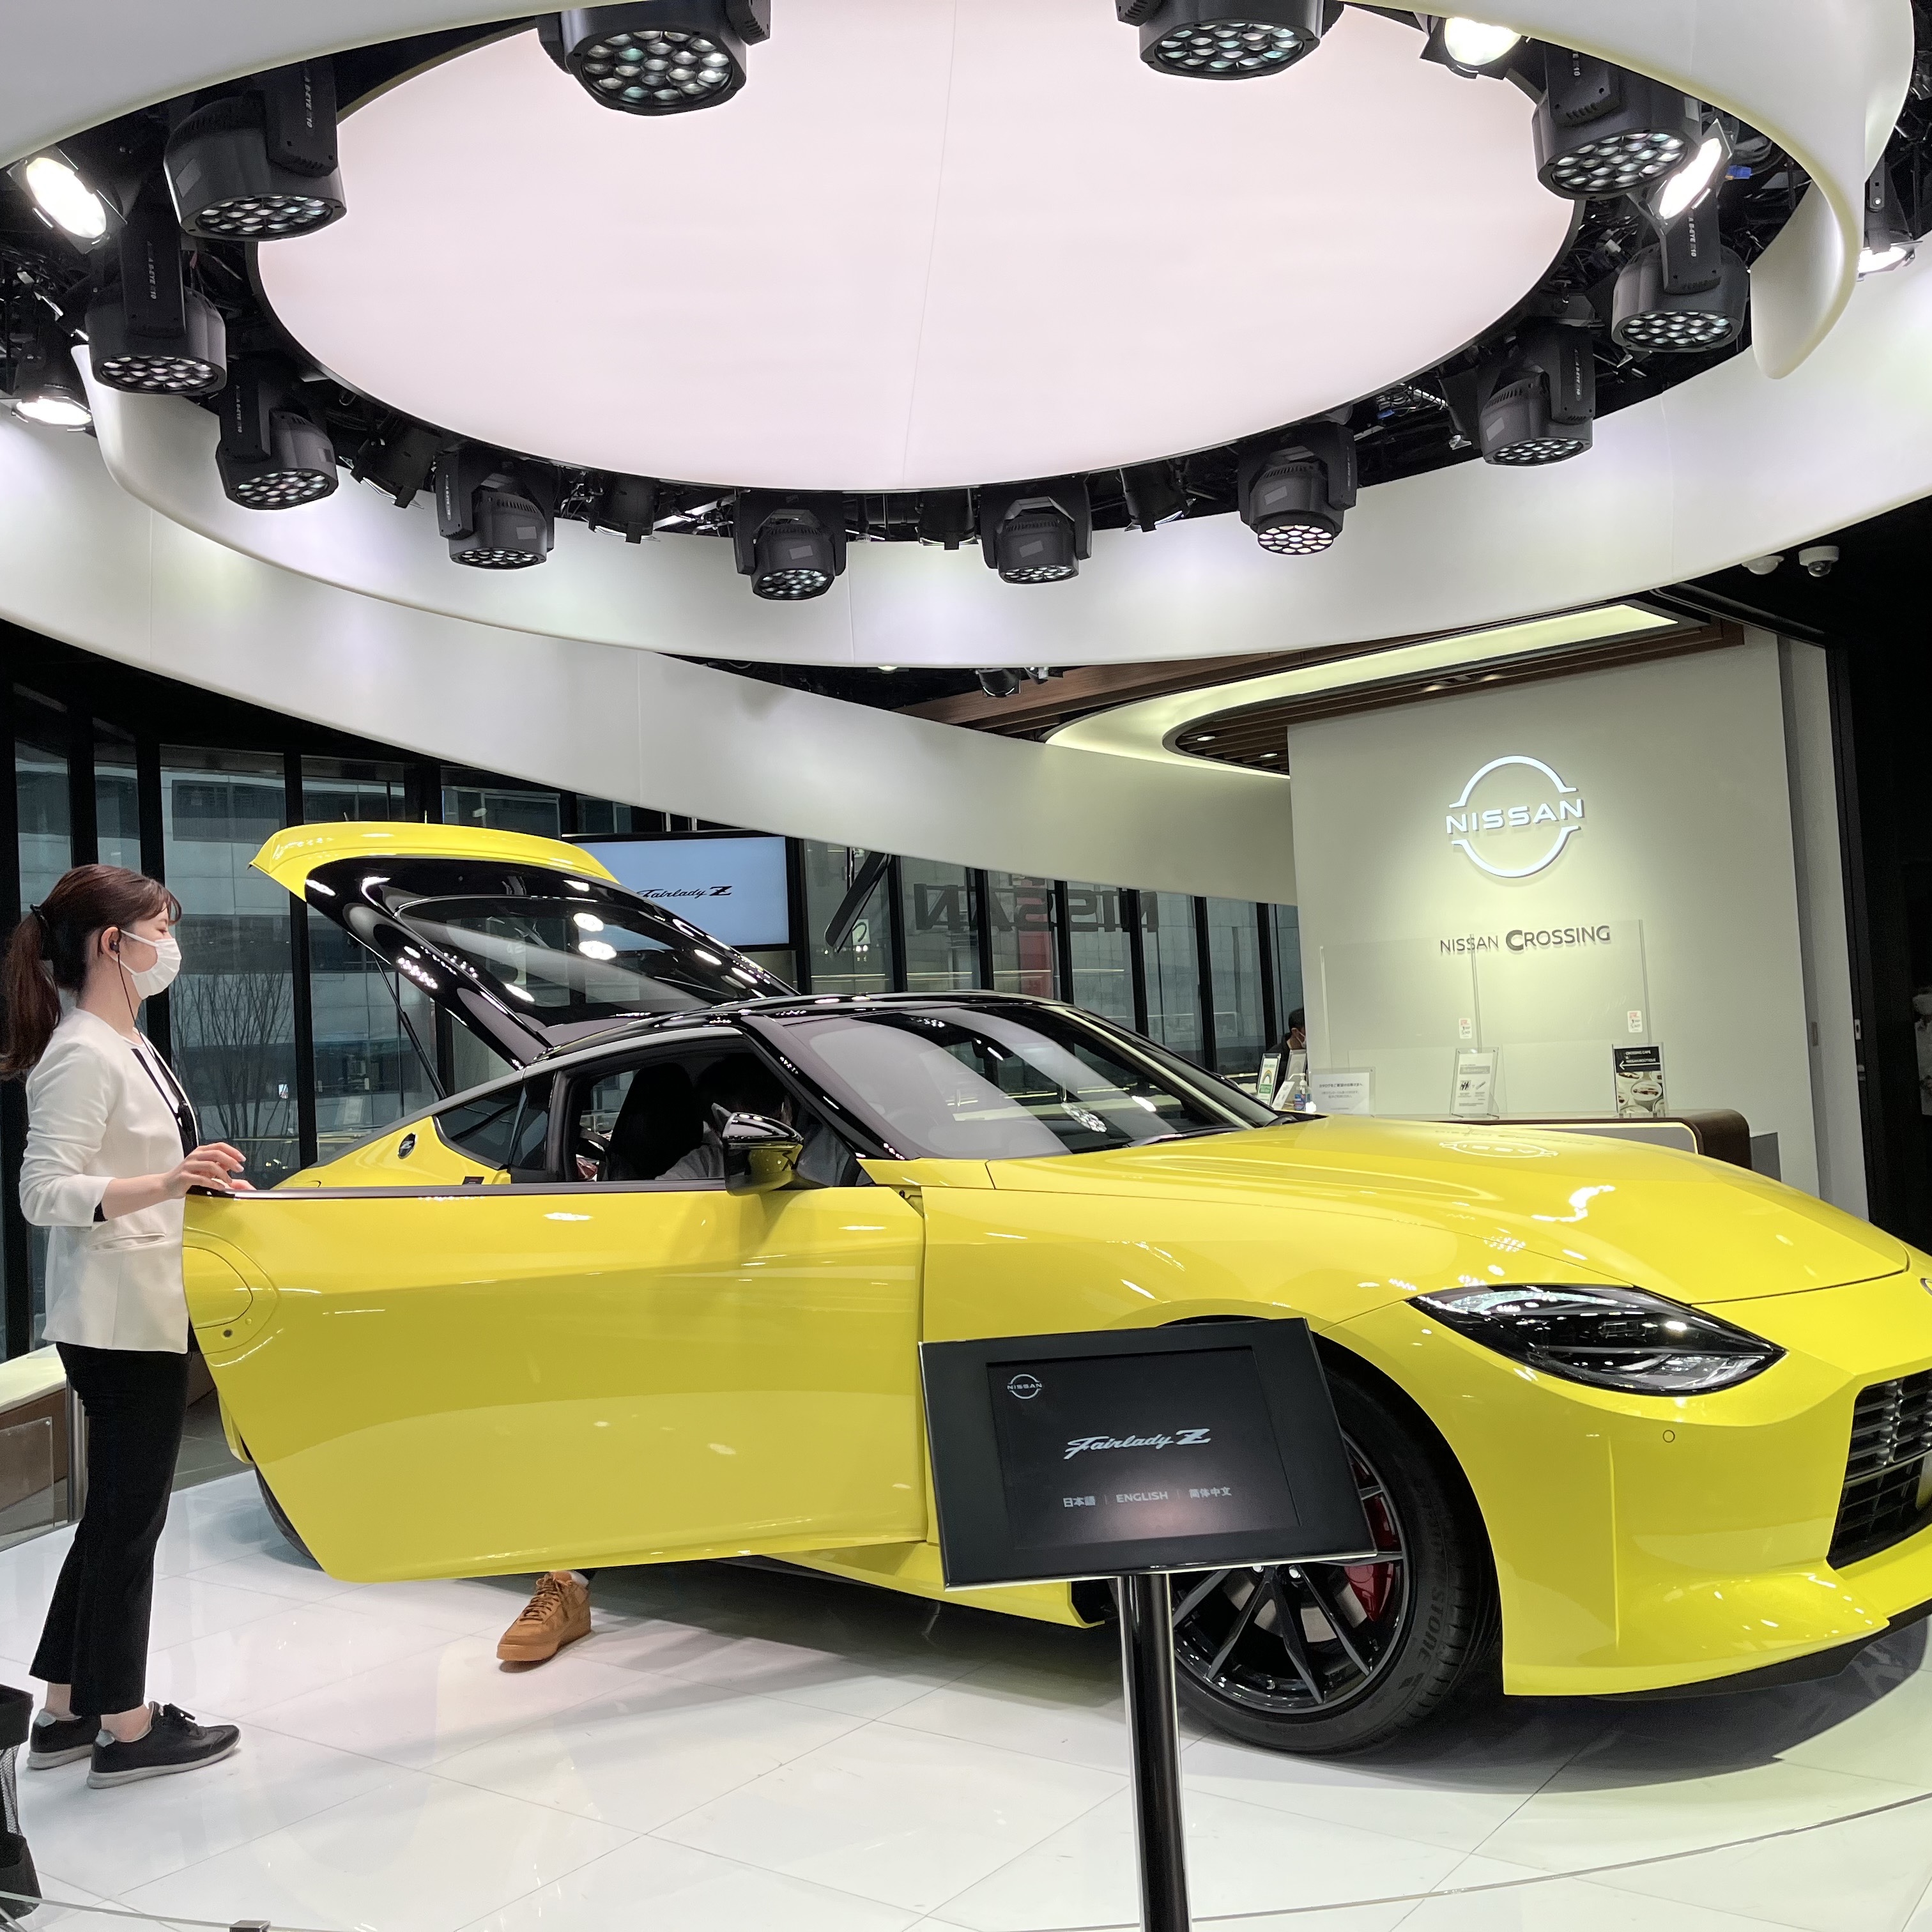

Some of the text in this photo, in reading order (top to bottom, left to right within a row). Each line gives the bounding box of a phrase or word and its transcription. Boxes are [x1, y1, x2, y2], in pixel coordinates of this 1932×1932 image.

[1446, 799, 1585, 834] NISSAN
[709, 885, 733, 896] Z
[1440, 925, 1611, 953] NISSAN CROSSING
[1063, 1428, 1212, 1460] Fairlady Z
[1116, 1491, 1169, 1503] ENGLISH
[1189, 1486, 1232, 1499] 简体中文
[1063, 1496, 1096, 1508] 日本語
